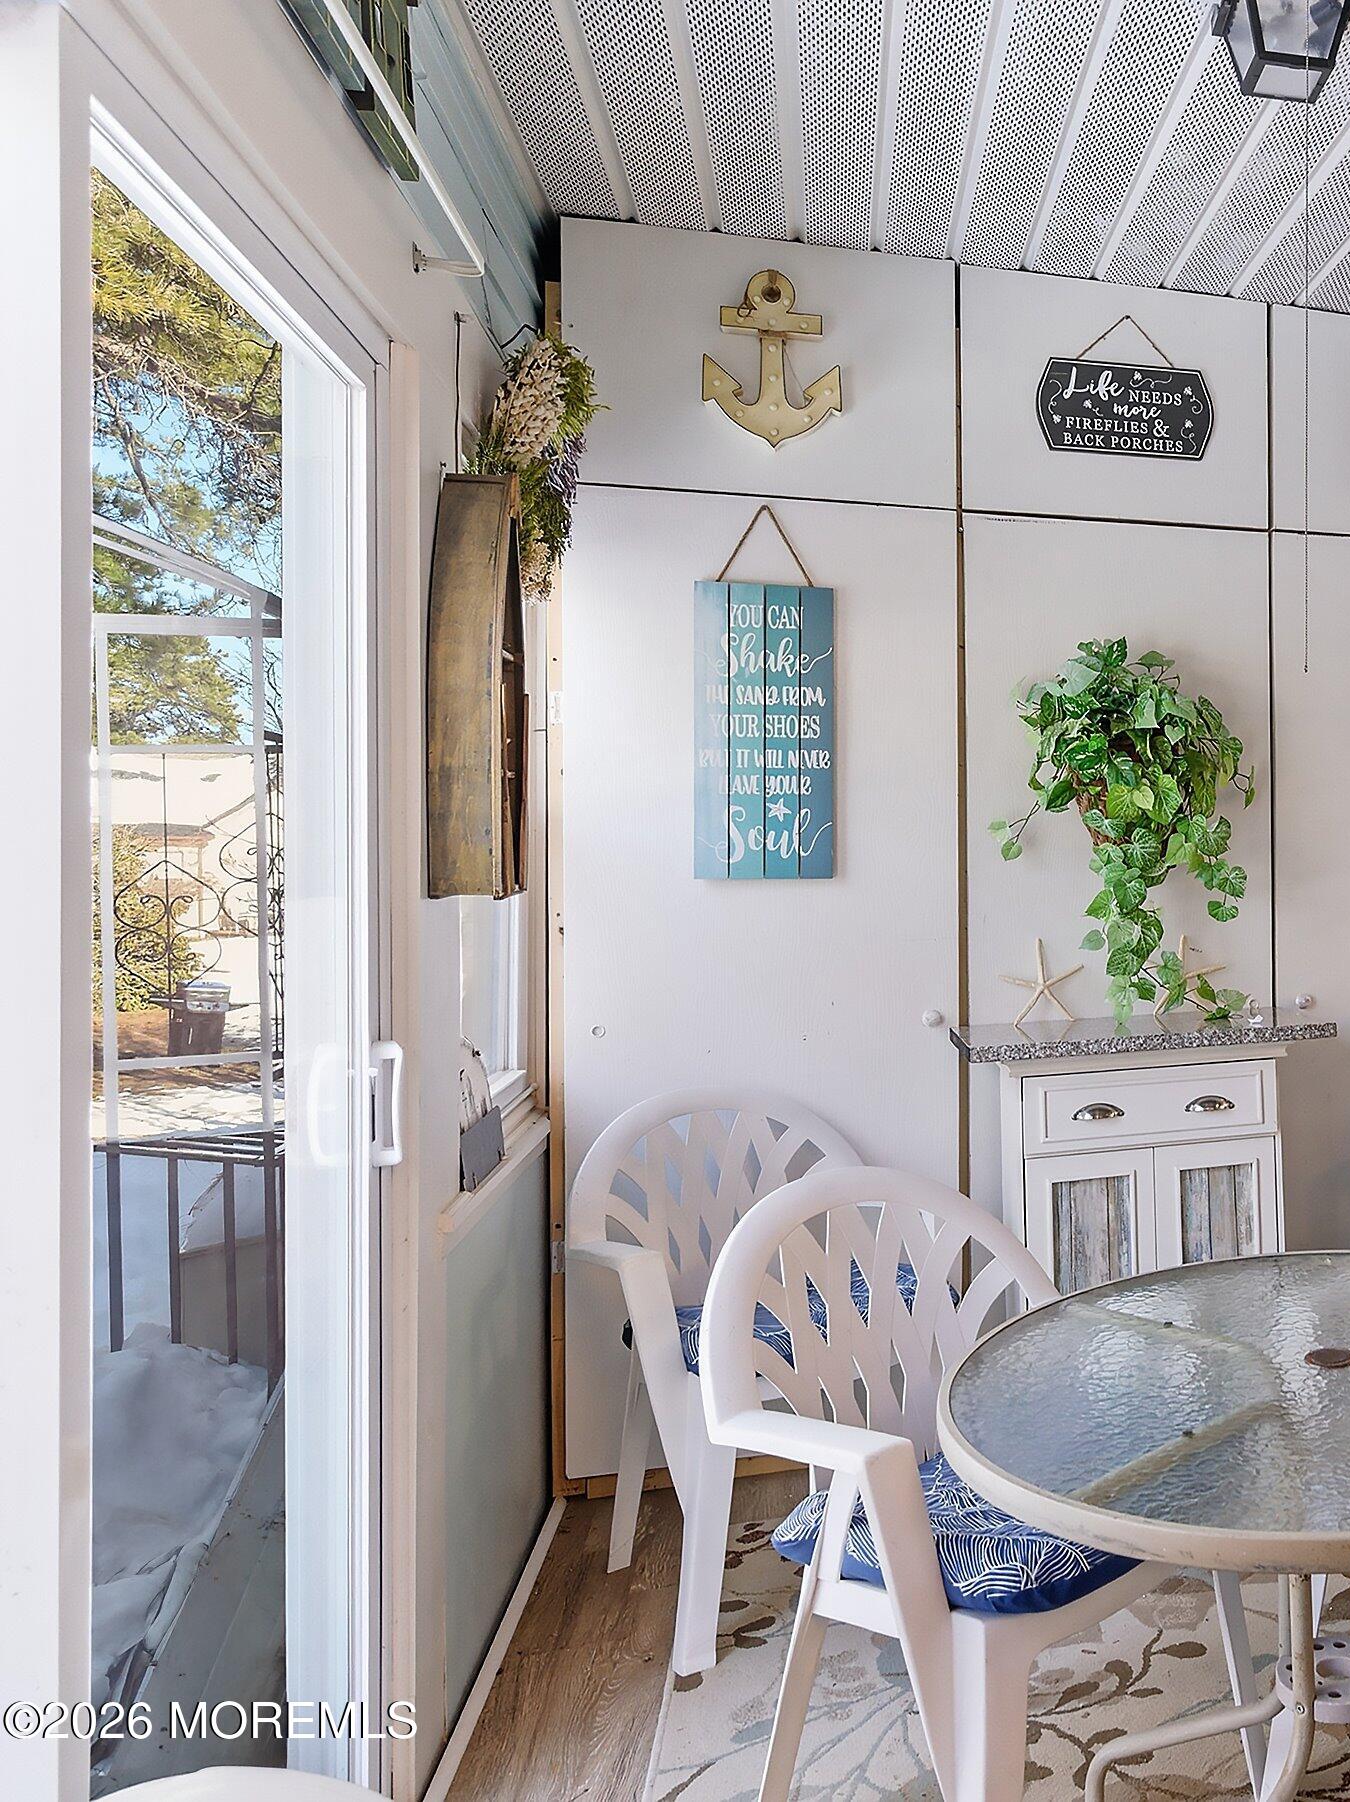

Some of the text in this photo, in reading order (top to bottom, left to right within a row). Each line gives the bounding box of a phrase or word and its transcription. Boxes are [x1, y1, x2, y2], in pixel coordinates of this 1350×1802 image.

[1063, 366, 1183, 406] Life NEEDS
[1113, 402, 1162, 420] more
[1065, 416, 1170, 438] FIREFLIES &
[1063, 431, 1184, 453] BACK PORCHES
[725, 603, 804, 631] YOU CAN
[695, 631, 833, 678] Shake
[736, 684, 781, 706] SAND
[782, 685, 827, 708] FROM
[709, 713, 821, 740] YOUR SHOES
[736, 748, 752, 768] IT
[753, 748, 785, 769] WILL
[765, 774, 812, 797] YOUR
[697, 804, 833, 864] Soul
